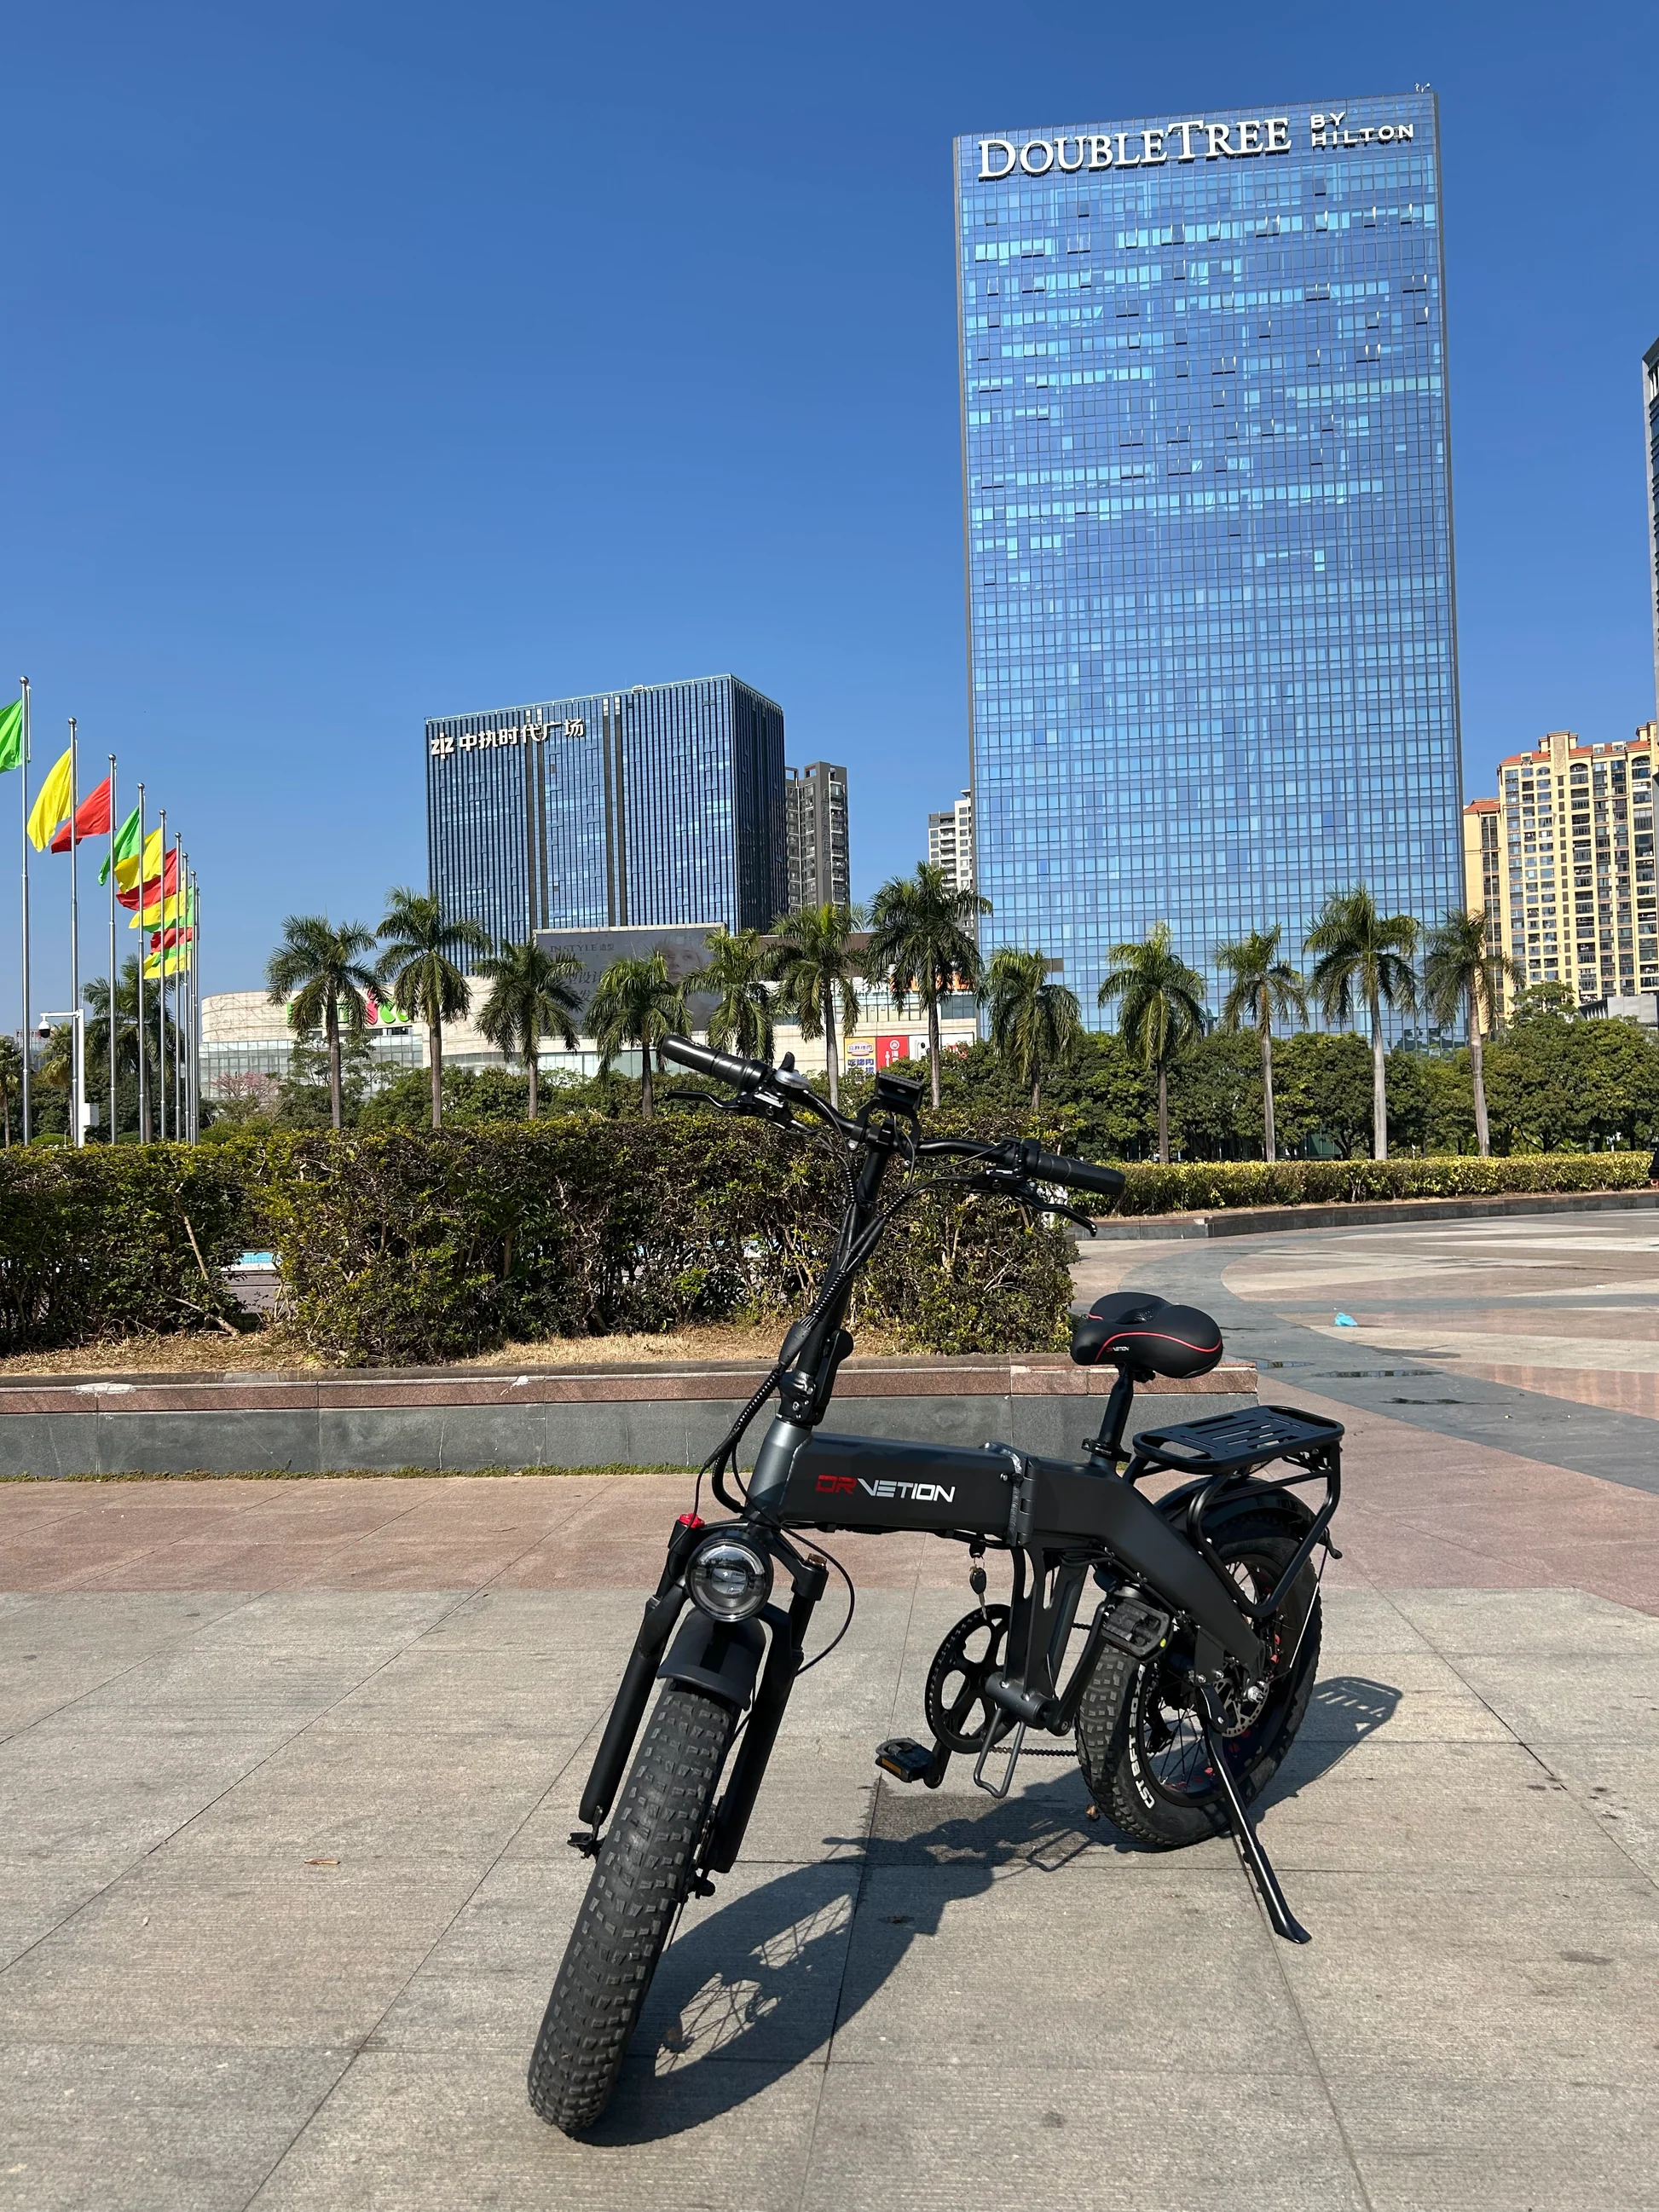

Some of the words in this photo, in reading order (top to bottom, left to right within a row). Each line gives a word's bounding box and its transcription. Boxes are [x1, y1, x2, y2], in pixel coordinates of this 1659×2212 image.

[1310, 112, 1346, 129] BY
[1311, 123, 1414, 147] HILTON
[459, 719, 585, 752] 中执时代广场
[815, 1474, 956, 1503] DRVETION
[1129, 1734, 1141, 1776] BFT
[1135, 1779, 1155, 1809] CST
